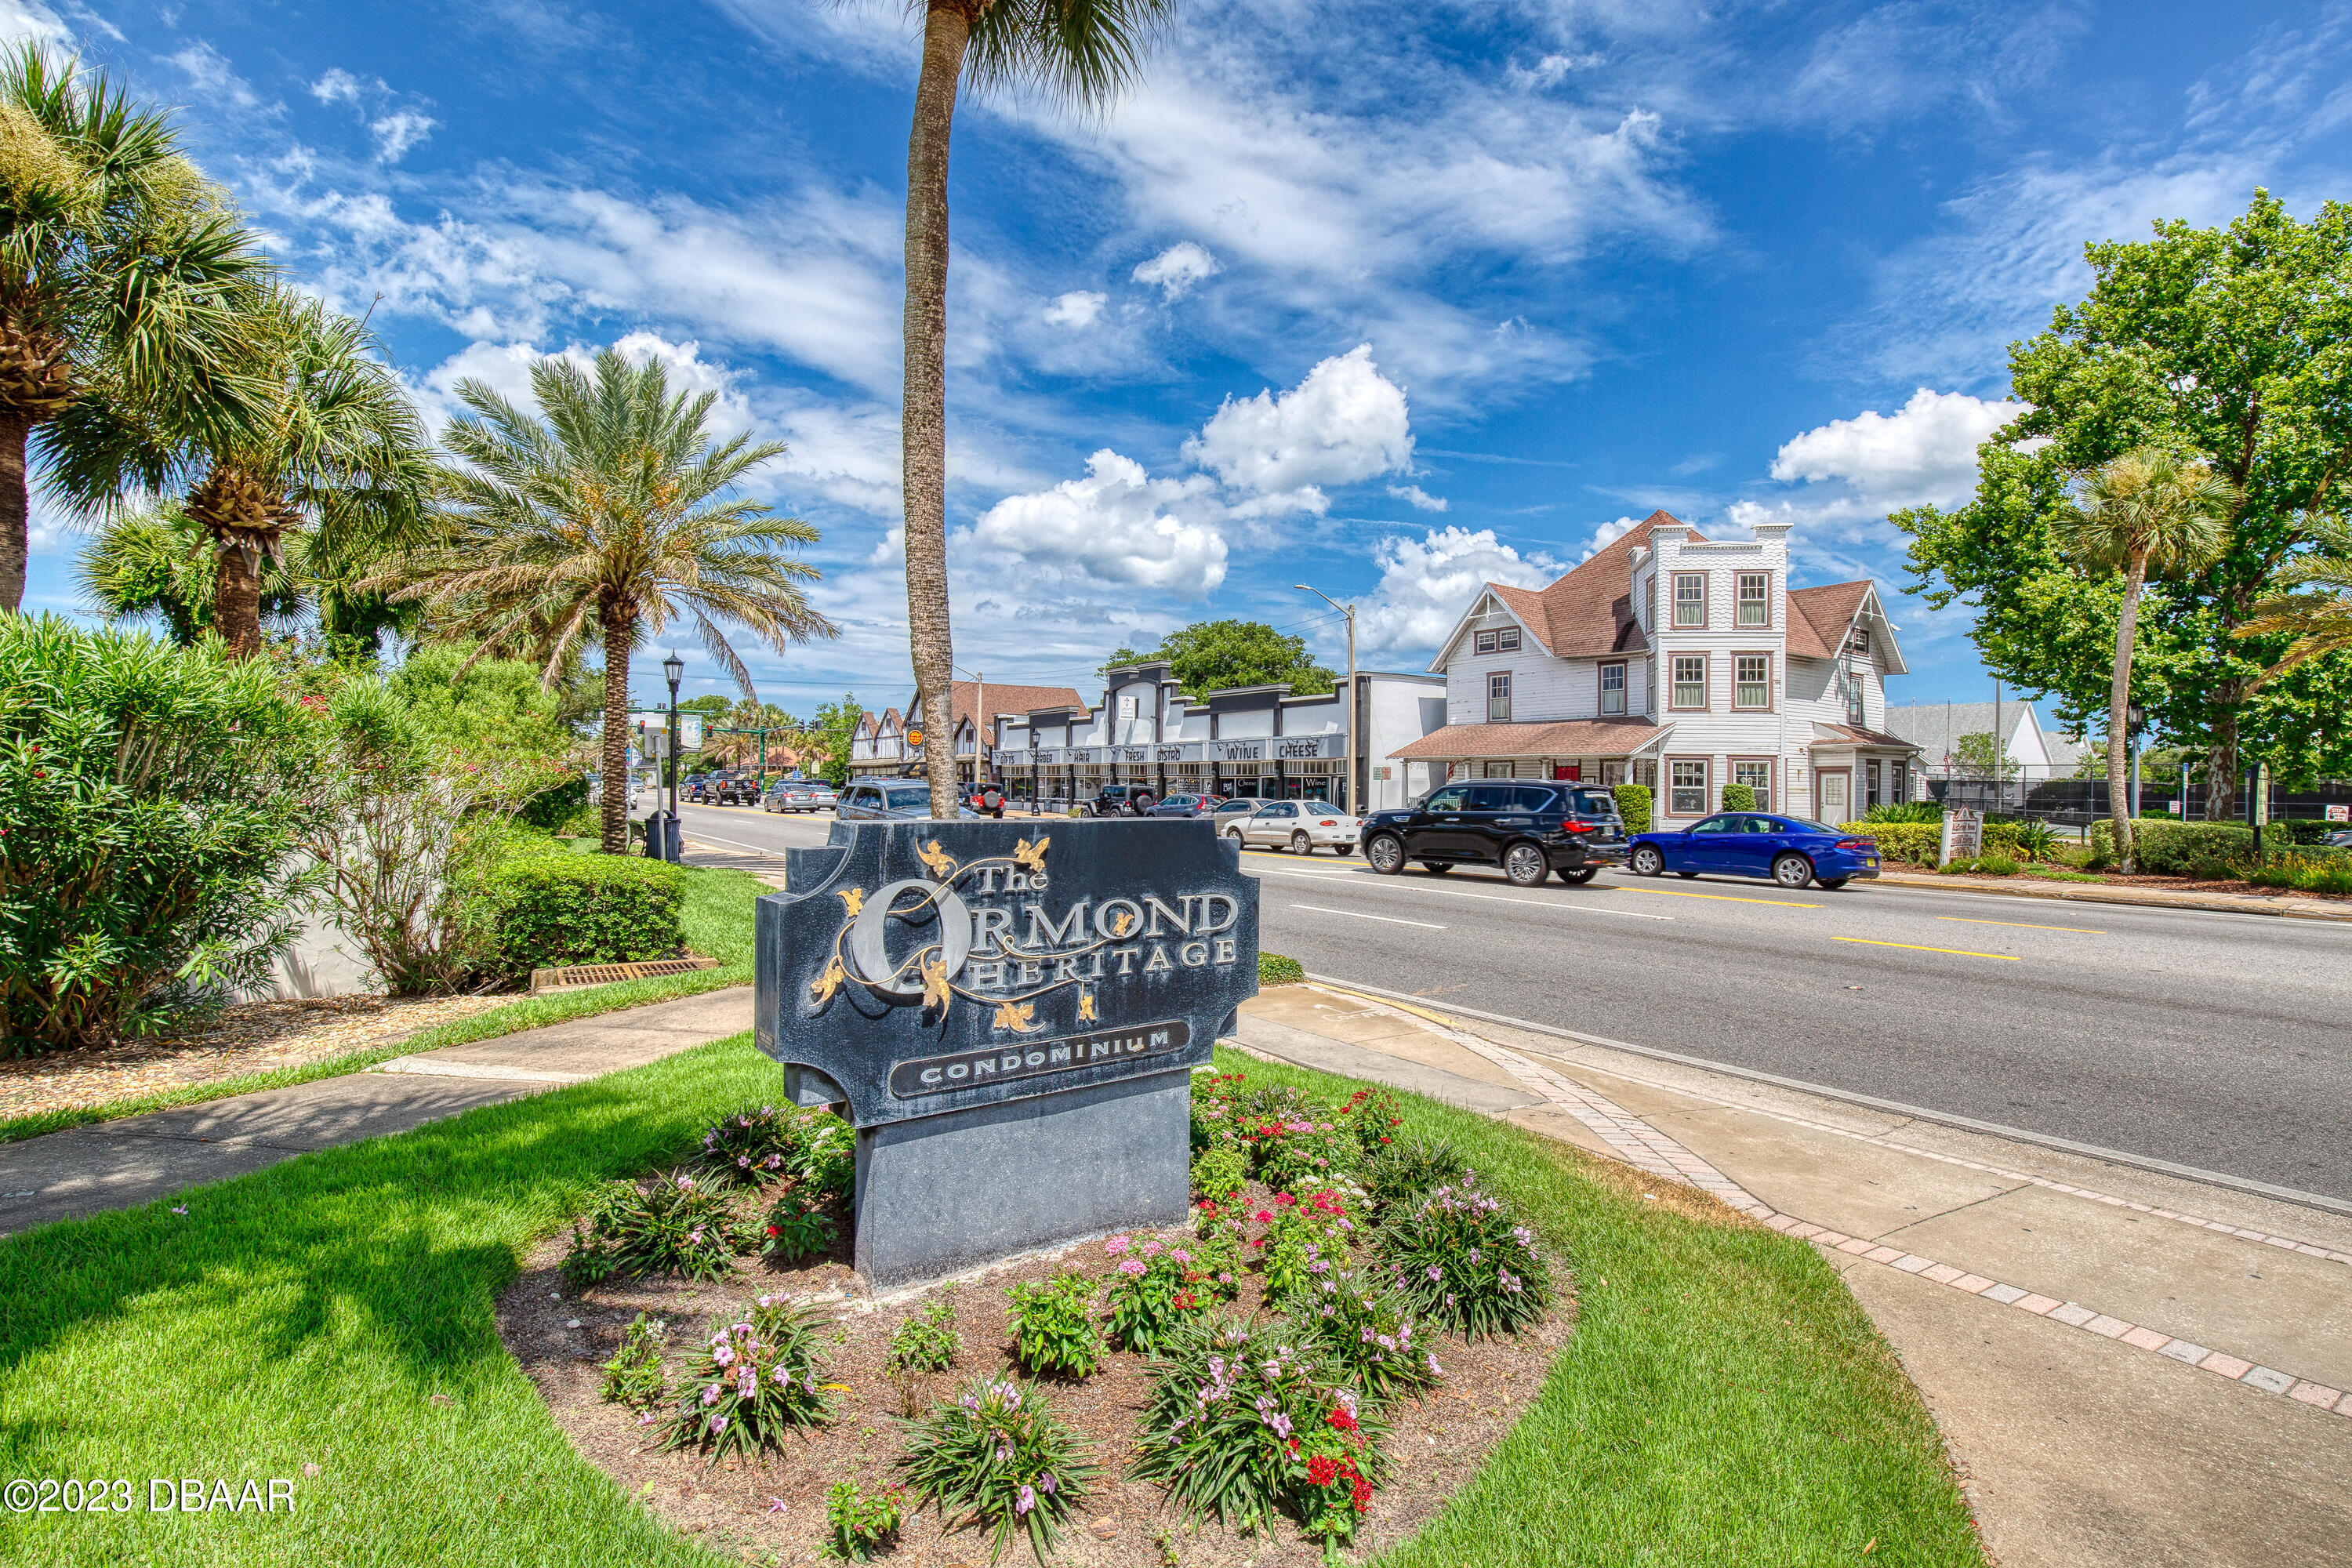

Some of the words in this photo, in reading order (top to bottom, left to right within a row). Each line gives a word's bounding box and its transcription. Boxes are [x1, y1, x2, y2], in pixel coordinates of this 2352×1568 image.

[1125, 750, 1145, 762] FRESH
[1157, 750, 1181, 761] BISTRO
[1227, 747, 1259, 760] WINE
[1279, 744, 1318, 757] CHEESE
[1000, 755, 1015, 764] GIFTS
[1074, 753, 1090, 763] HAIR
[1237, 779, 1257, 787] Cheese
[1305, 778, 1327, 786] Wine
[974, 863, 1048, 894] The
[851, 879, 1240, 995] ORMOND
[969, 939, 1237, 991] HERITAGE
[920, 1029, 1169, 1085] CONDOMINIUM
